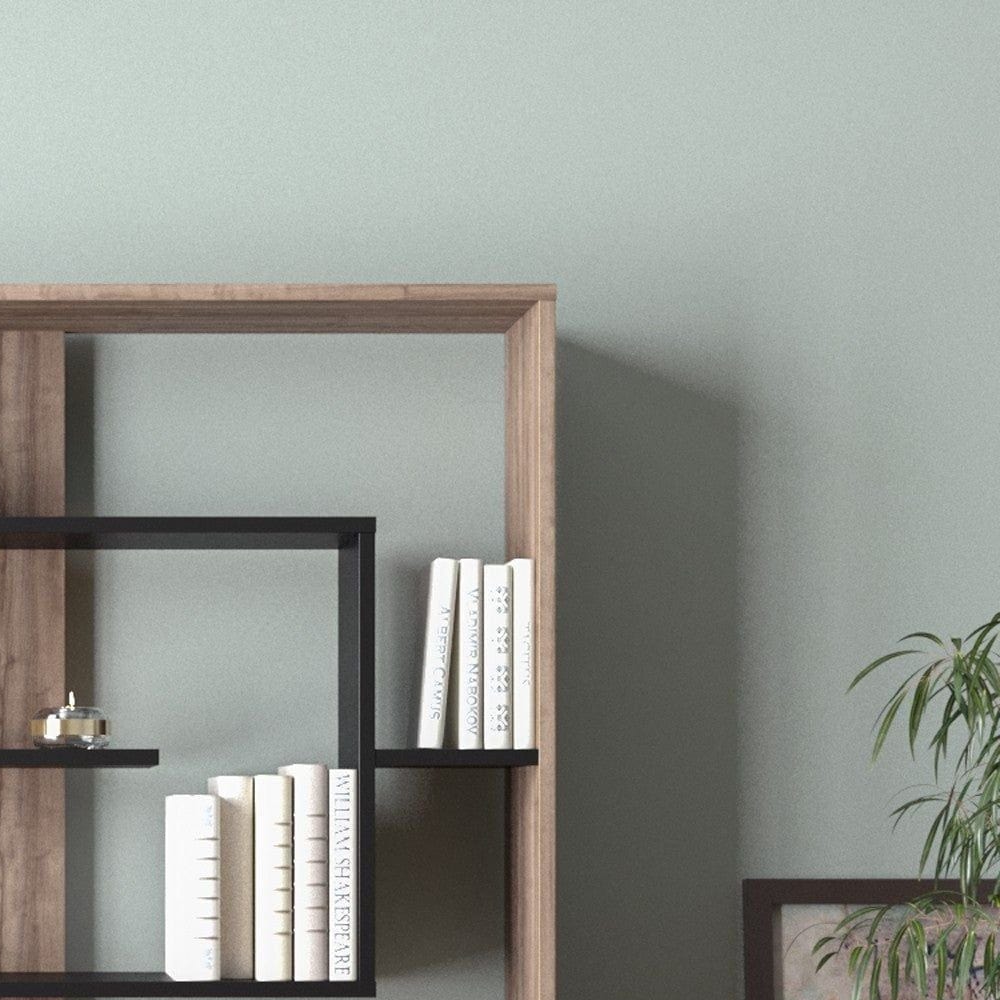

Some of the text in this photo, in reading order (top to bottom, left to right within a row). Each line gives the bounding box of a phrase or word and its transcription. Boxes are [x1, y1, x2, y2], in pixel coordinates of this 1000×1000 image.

[466, 663, 480, 736] NABOKOV
[334, 774, 351, 976] WILLIAM SHAKESPEARE
